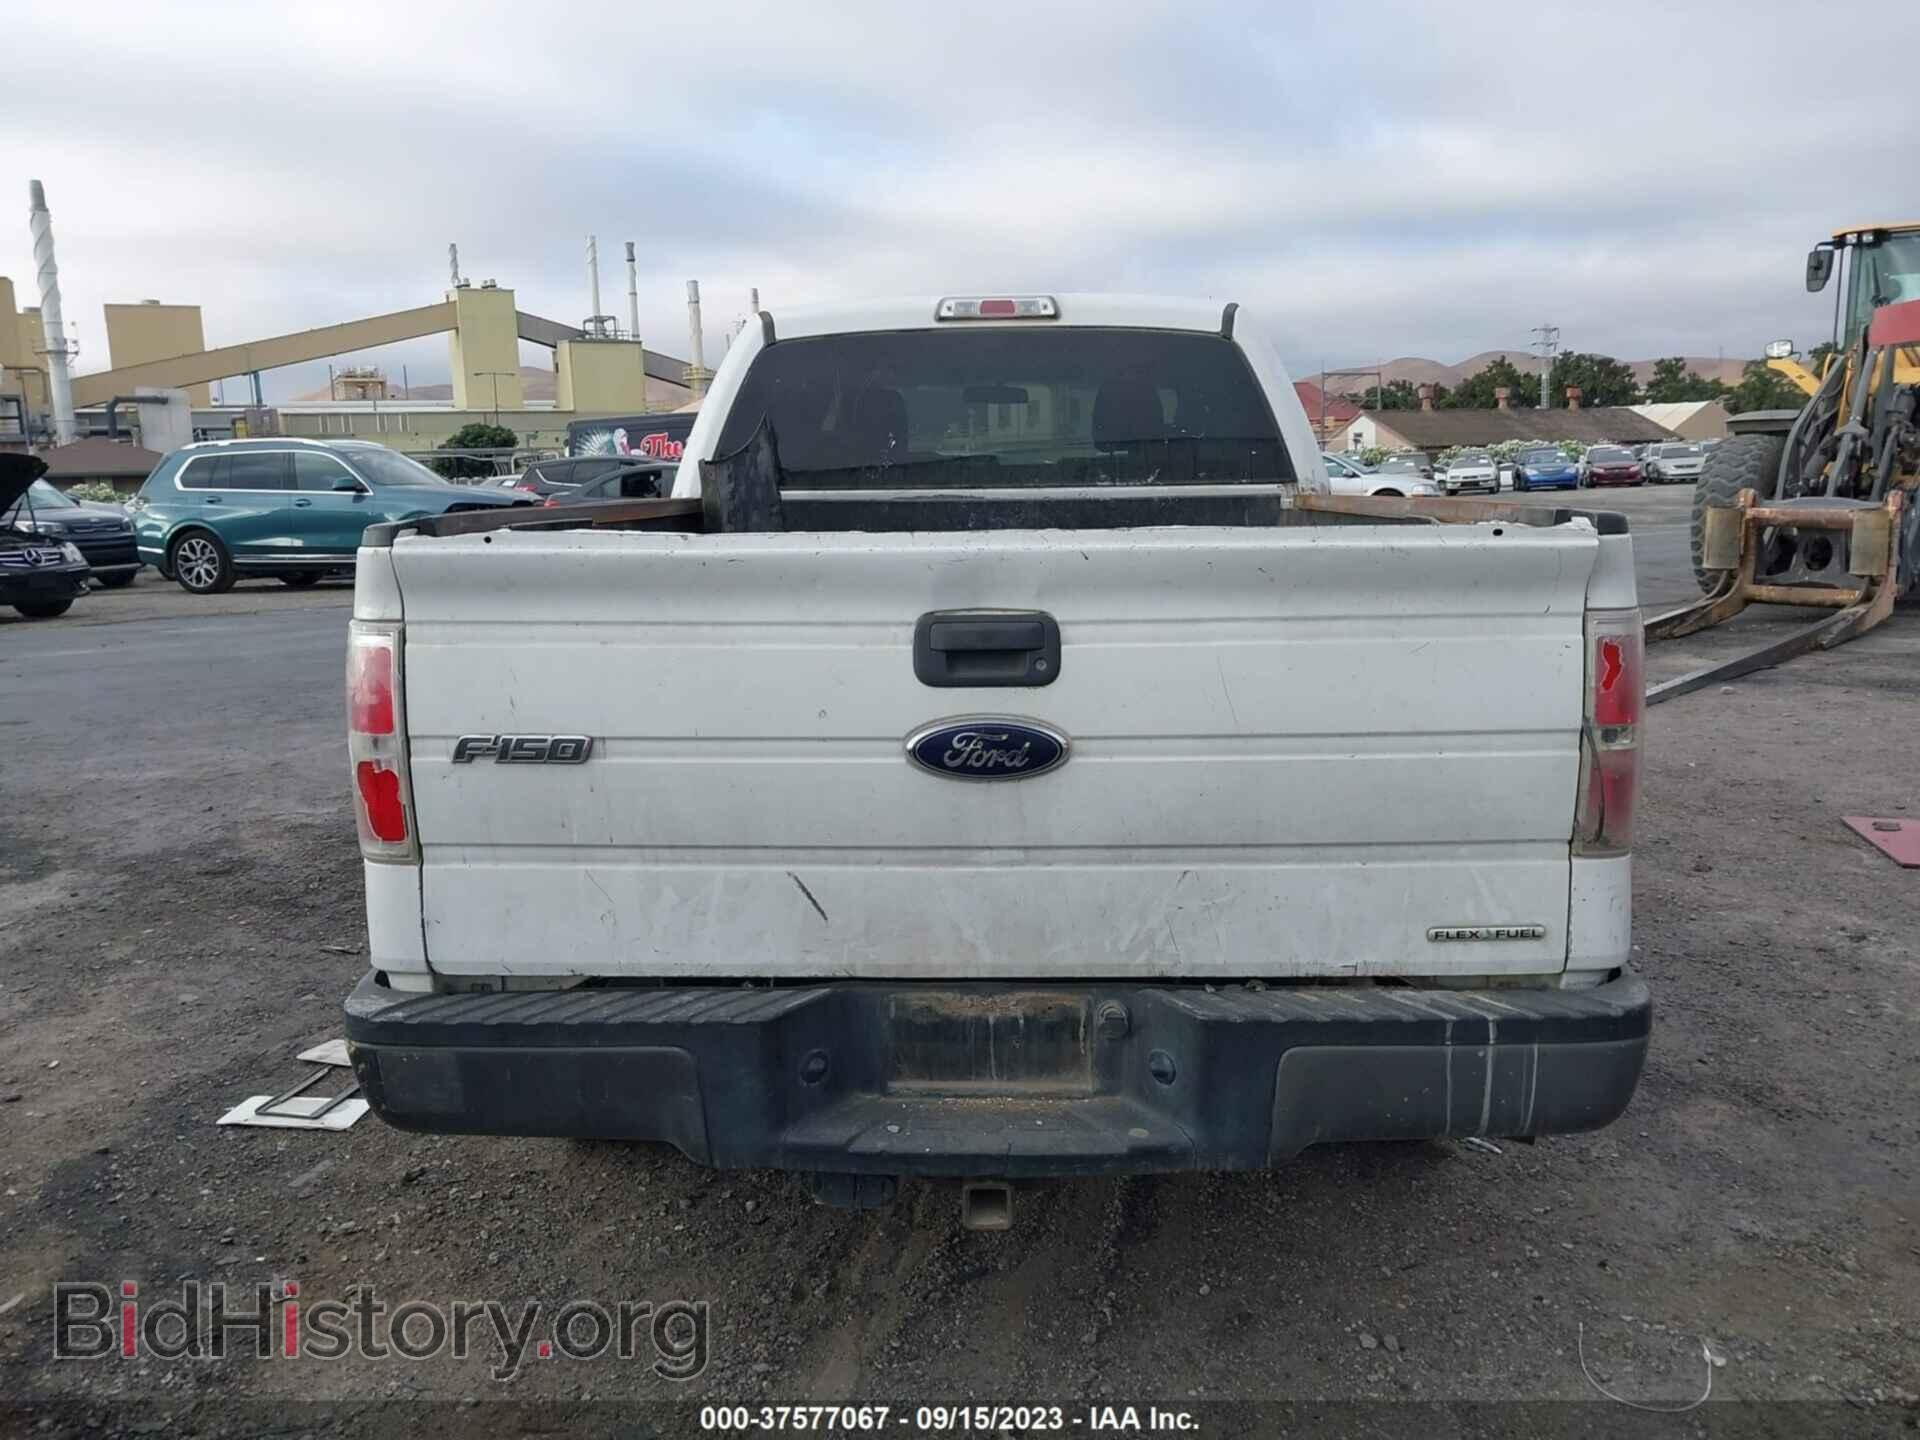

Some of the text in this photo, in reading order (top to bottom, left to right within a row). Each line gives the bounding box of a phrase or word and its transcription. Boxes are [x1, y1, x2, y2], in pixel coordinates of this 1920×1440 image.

[640, 432, 683, 458] The
[452, 734, 593, 764] F-150
[943, 732, 1031, 767] Ford
[1434, 928, 1543, 940] FLEX FUEL
